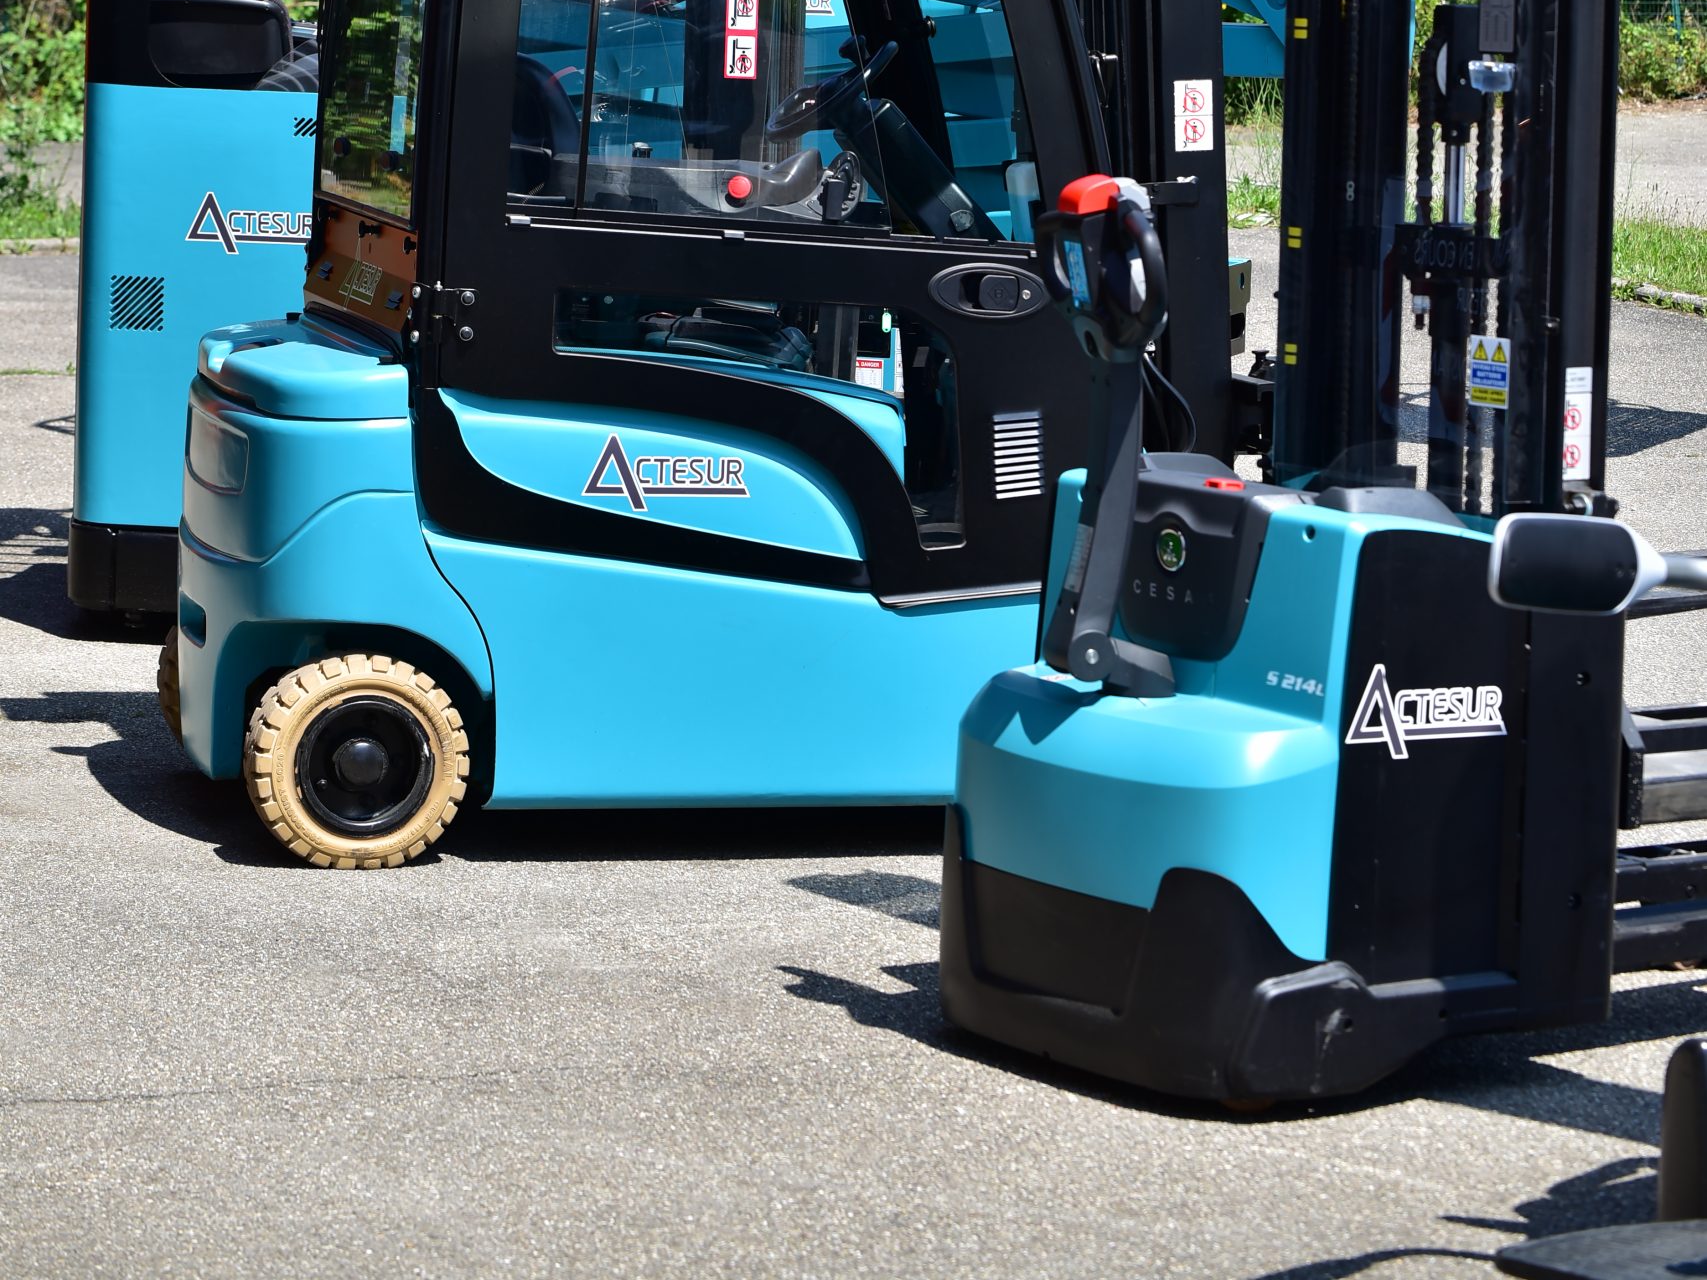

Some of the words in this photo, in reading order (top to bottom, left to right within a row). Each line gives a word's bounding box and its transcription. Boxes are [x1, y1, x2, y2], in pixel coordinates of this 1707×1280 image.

[582, 432, 750, 511] ACTESUR
[1133, 579, 1214, 605] CESA
[1265, 670, 1280, 686] S
[1281, 673, 1325, 697] 214L
[1344, 663, 1508, 760] ACTESUR
